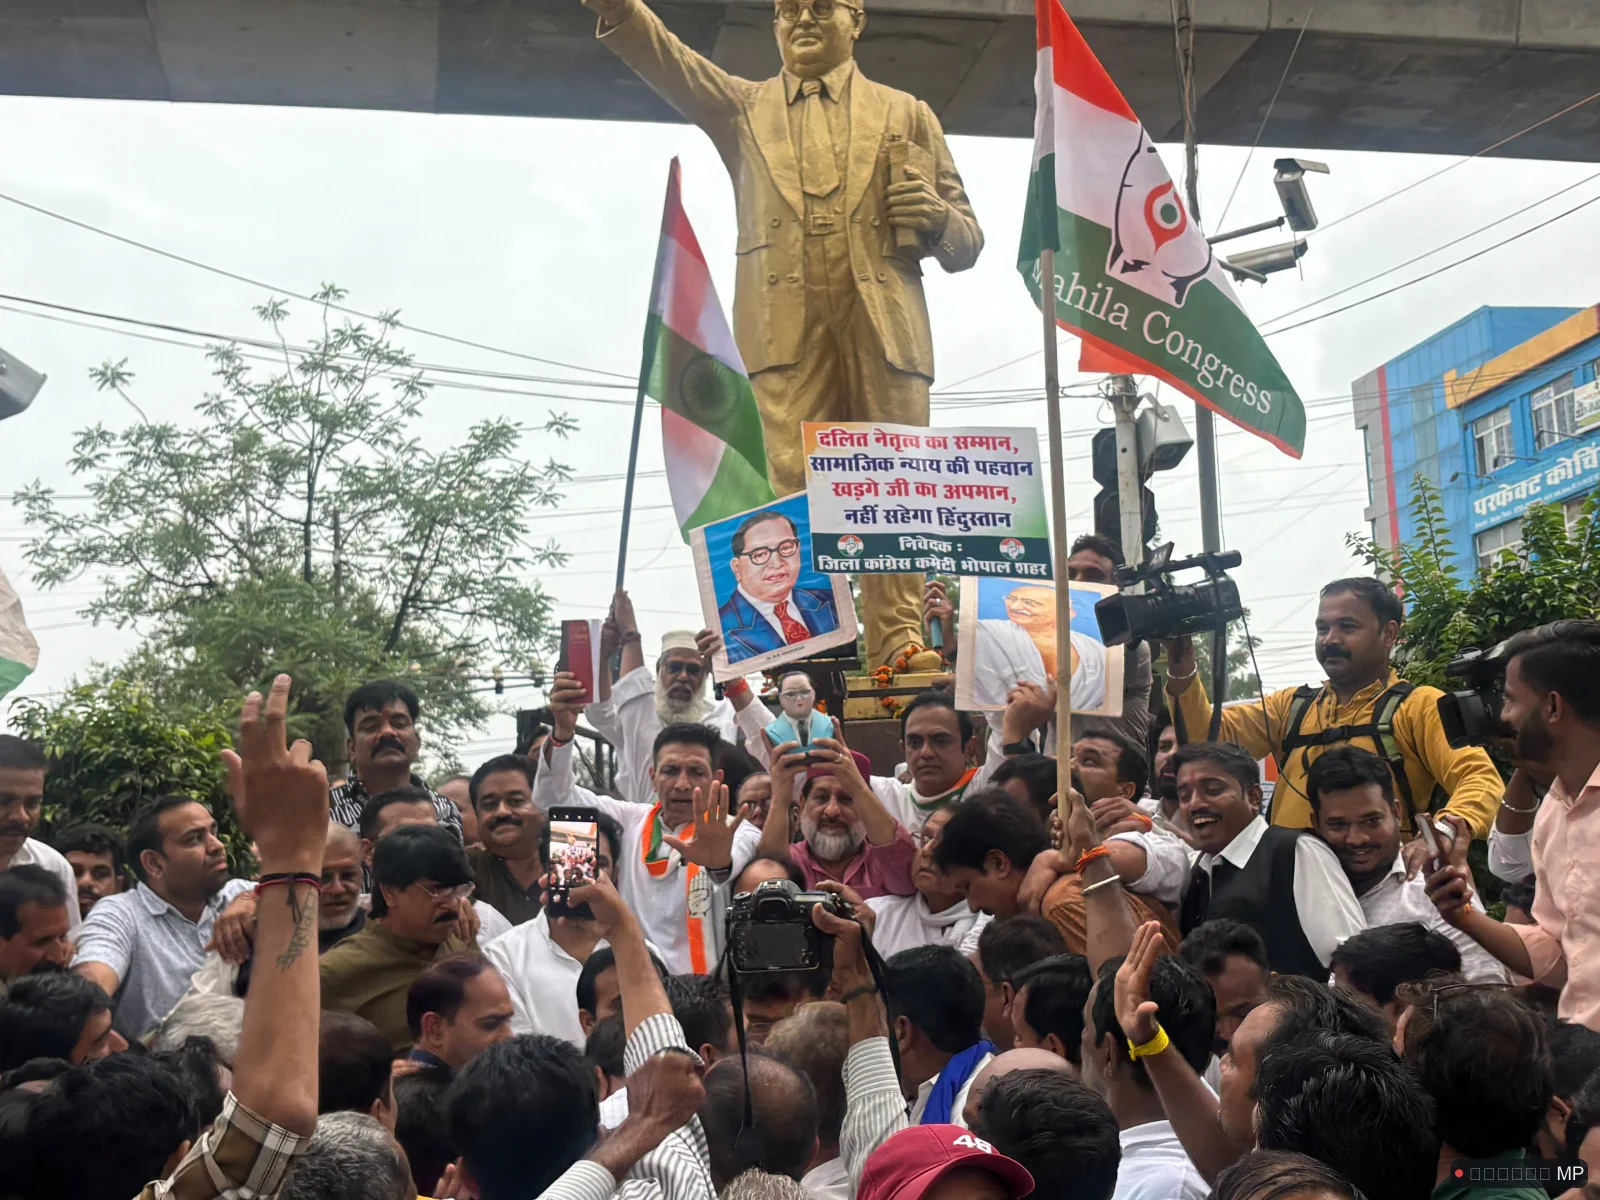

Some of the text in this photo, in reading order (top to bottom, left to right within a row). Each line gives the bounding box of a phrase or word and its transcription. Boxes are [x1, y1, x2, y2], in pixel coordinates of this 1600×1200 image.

[1142, 310, 1272, 414] Congress
[818, 428, 1019, 454] दलित नेतृत्व का सम्मान,
[810, 454, 1033, 476] सामाजिक न्याय की पहचान
[885, 478, 910, 497] जी
[915, 482, 937, 498] का
[943, 484, 1017, 504] अपमान,
[844, 505, 1012, 531] नहीं सहेगा हिंदुस्तान
[818, 556, 860, 571] जिला
[864, 554, 911, 571] कांग्रेस
[961, 558, 1011, 574] भोपाल
[1015, 563, 1047, 575] शहर
